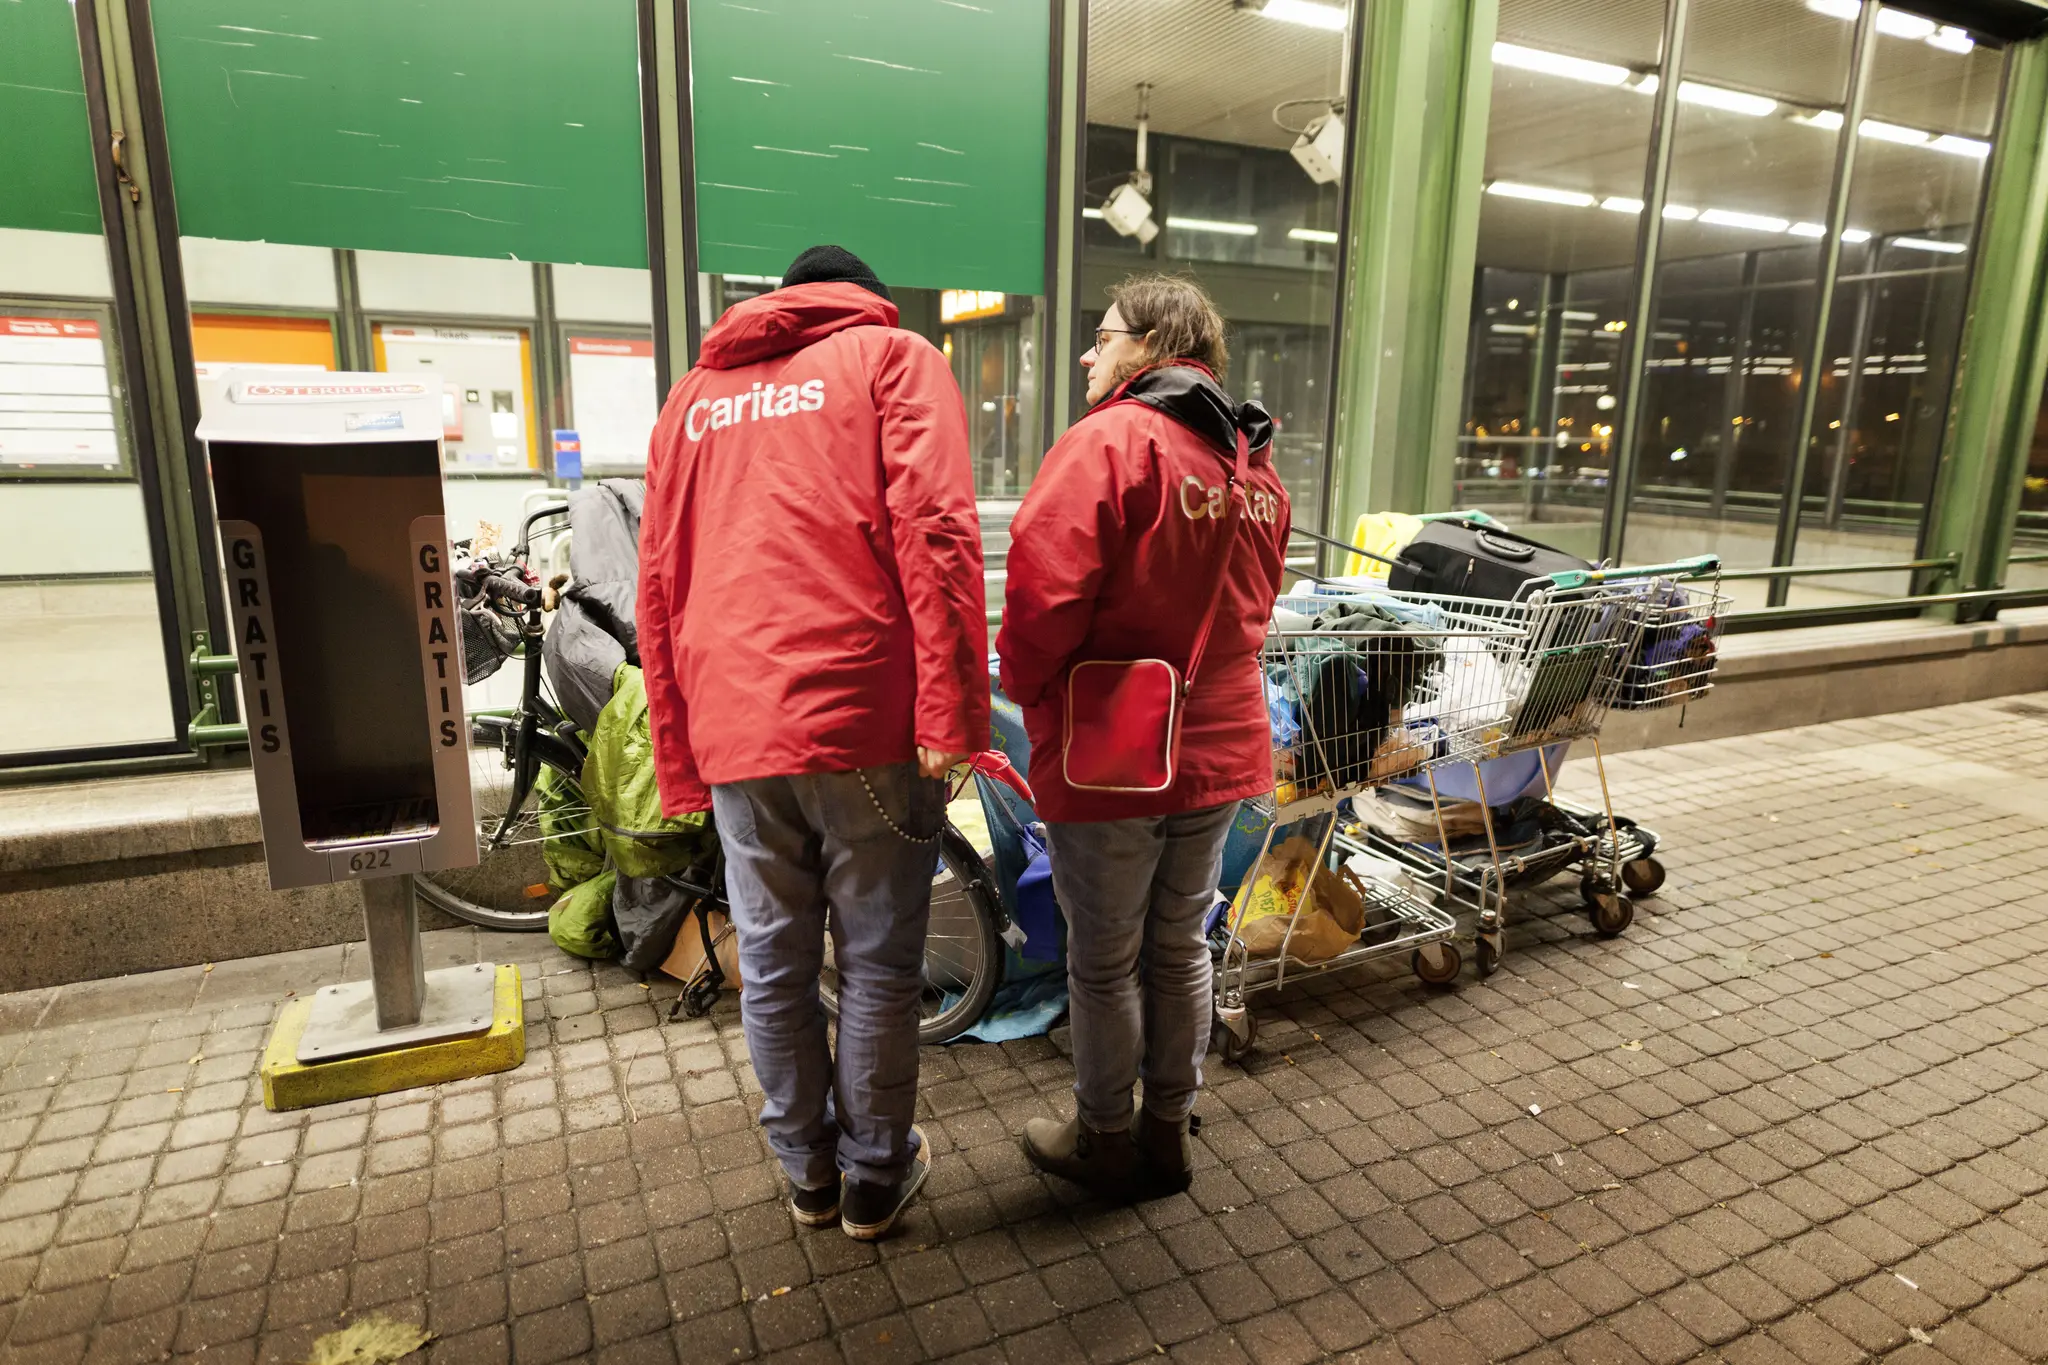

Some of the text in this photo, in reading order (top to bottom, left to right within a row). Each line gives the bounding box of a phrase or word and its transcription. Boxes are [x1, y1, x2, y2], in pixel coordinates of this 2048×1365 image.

[684, 379, 825, 442] Caritas
[1181, 475, 1278, 524] Catas
[232, 539, 281, 753] GRATIS
[419, 544, 458, 747] GRATIS
[350, 850, 392, 872] 622
